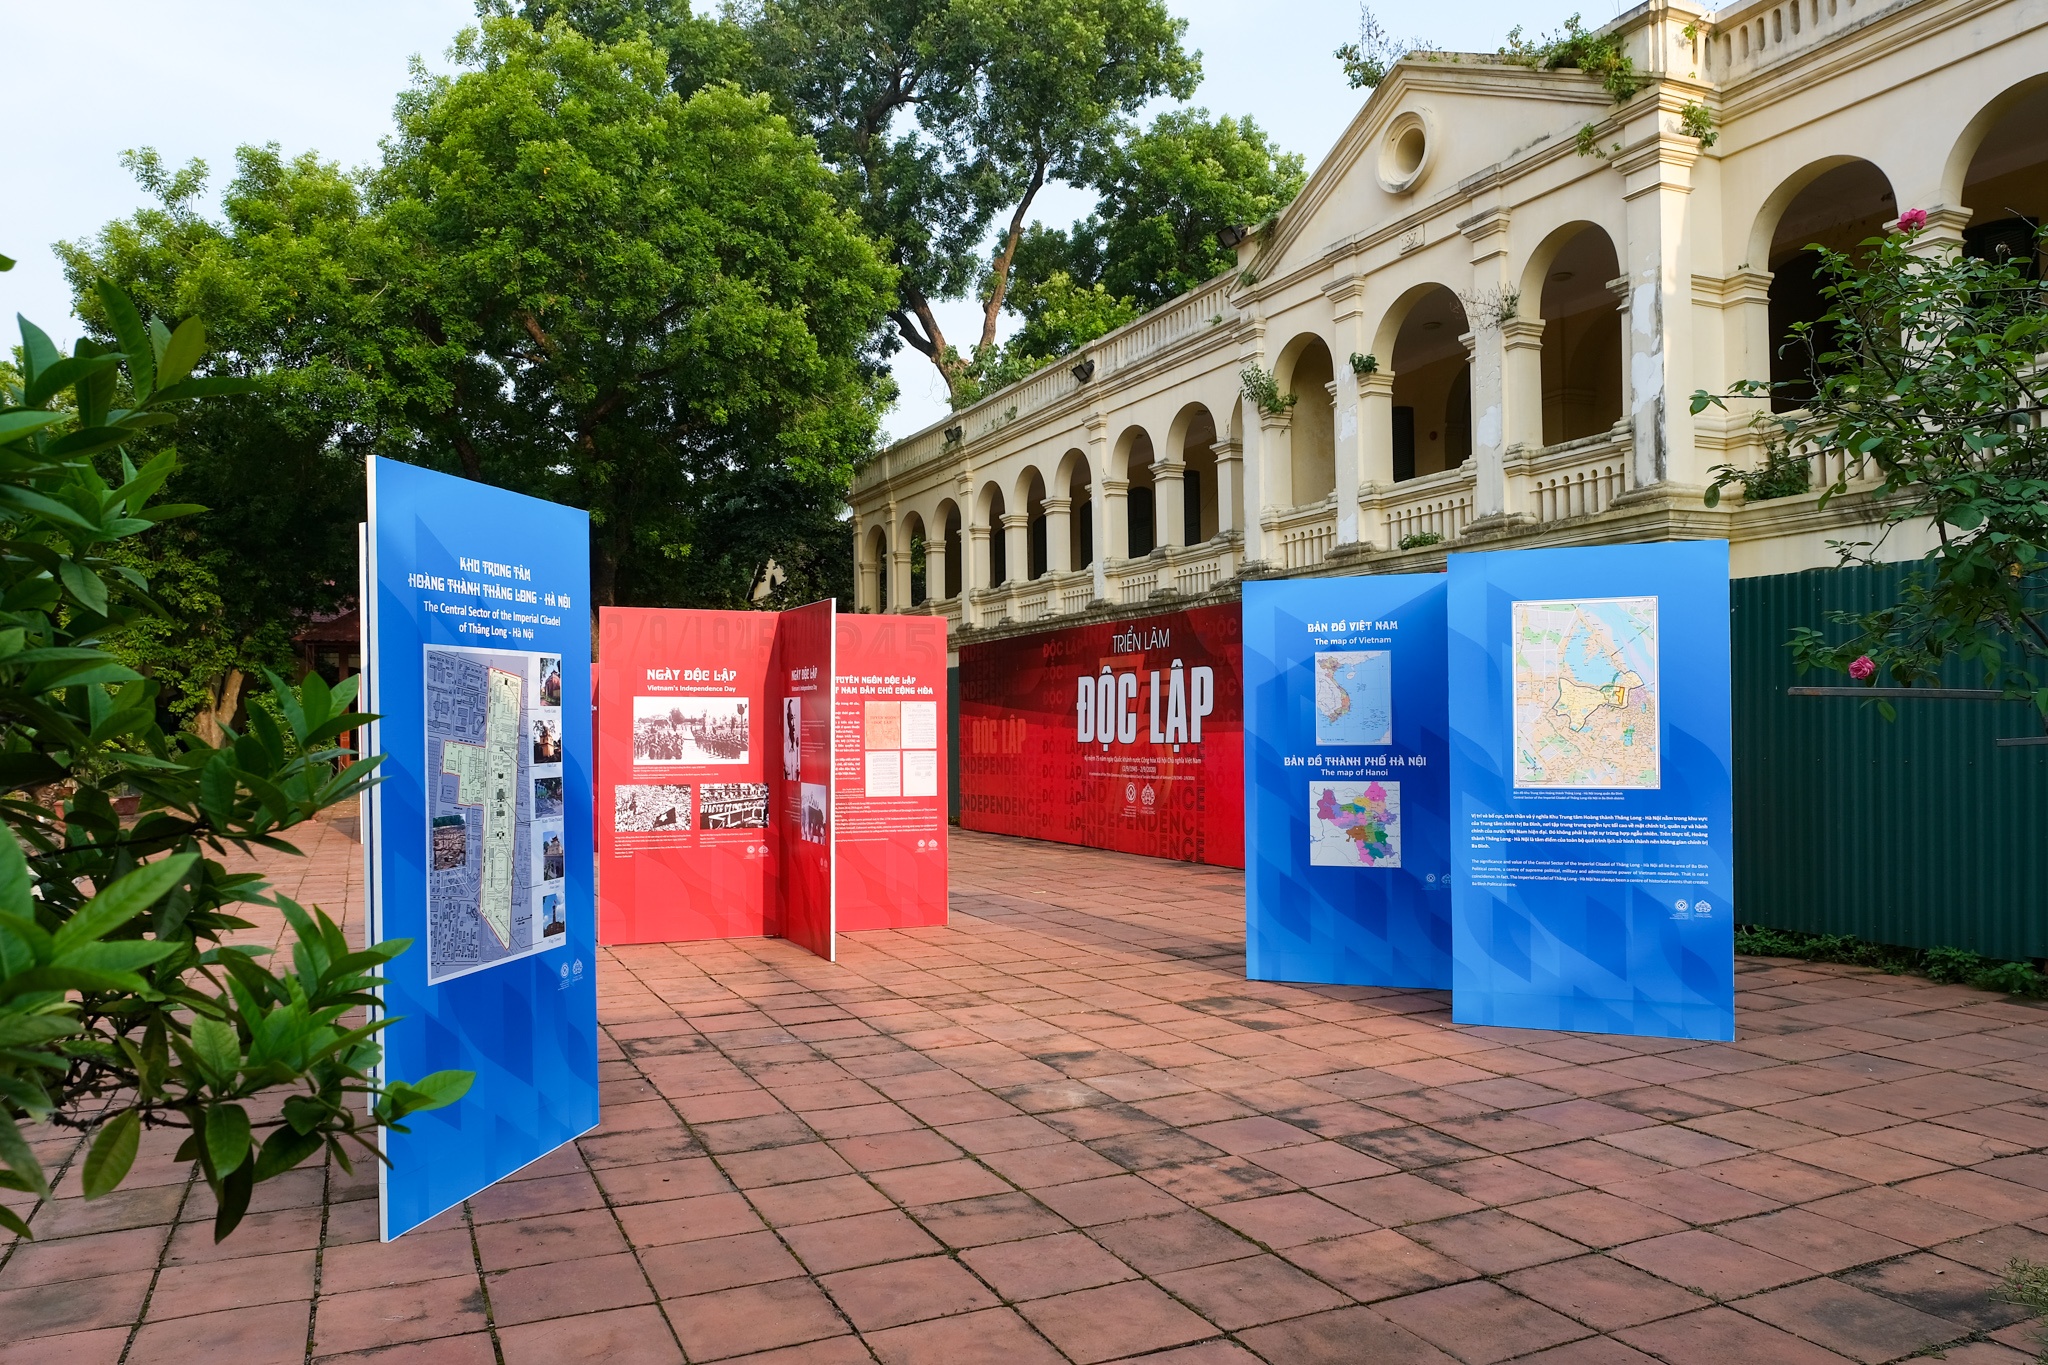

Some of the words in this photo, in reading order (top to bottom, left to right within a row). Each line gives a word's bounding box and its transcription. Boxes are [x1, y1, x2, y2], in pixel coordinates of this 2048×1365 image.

[460, 556, 480, 573] KHU
[482, 561, 511, 578] TRUNG
[514, 564, 531, 581] TÂM
[408, 571, 445, 592] HOÀNG
[447, 577, 481, 596] THÀNH
[482, 584, 513, 601] THĂNG
[515, 589, 537, 604] LONG
[544, 591, 556, 607] HÀ
[558, 593, 571, 610] NỘI
[424, 601, 438, 612] The
[440, 603, 467, 616] Central
[468, 606, 491, 618] Sector
[492, 609, 499, 619] of
[500, 610, 512, 620] the
[513, 612, 539, 624] Imperial
[540, 615, 561, 626] Citadel
[459, 623, 467, 633] of
[469, 622, 490, 637] Thăng
[491, 625, 507, 638] Long
[513, 627, 521, 637] Hà
[523, 628, 534, 640] Nội
[1308, 621, 1328, 632] BẢN
[1331, 619, 1346, 632] ĐỒ
[1349, 620, 1372, 632] VIỆT
[1375, 621, 1398, 631] NAM
[1112, 625, 1141, 653] TRIỂN
[1144, 626, 1170, 650] LÃM
[647, 666, 681, 681] NGÀY
[684, 667, 710, 682] ĐỘC
[714, 668, 737, 683] LẬP
[791, 667, 801, 681] NGÀY
[862, 675, 882, 684] NGÔN
[884, 675, 900, 685] ĐỘC
[902, 675, 917, 685] LẬP
[841, 686, 858, 694] NAM
[878, 685, 893, 694] CHỦ
[895, 685, 916, 695] CỘNG
[917, 686, 934, 694] HÒA
[1076, 665, 1137, 752] ĐỘC
[1150, 658, 1214, 753] LẬP
[972, 716, 998, 758] ĐỘC
[1002, 714, 1026, 757] LẬP
[1284, 755, 1304, 766] BẢN
[1307, 754, 1322, 766] ĐỒ
[1325, 755, 1361, 766] THÀNH
[1364, 754, 1387, 766] PHỐ
[1389, 755, 1405, 766] HÀ
[1408, 755, 1426, 767] NỘI
